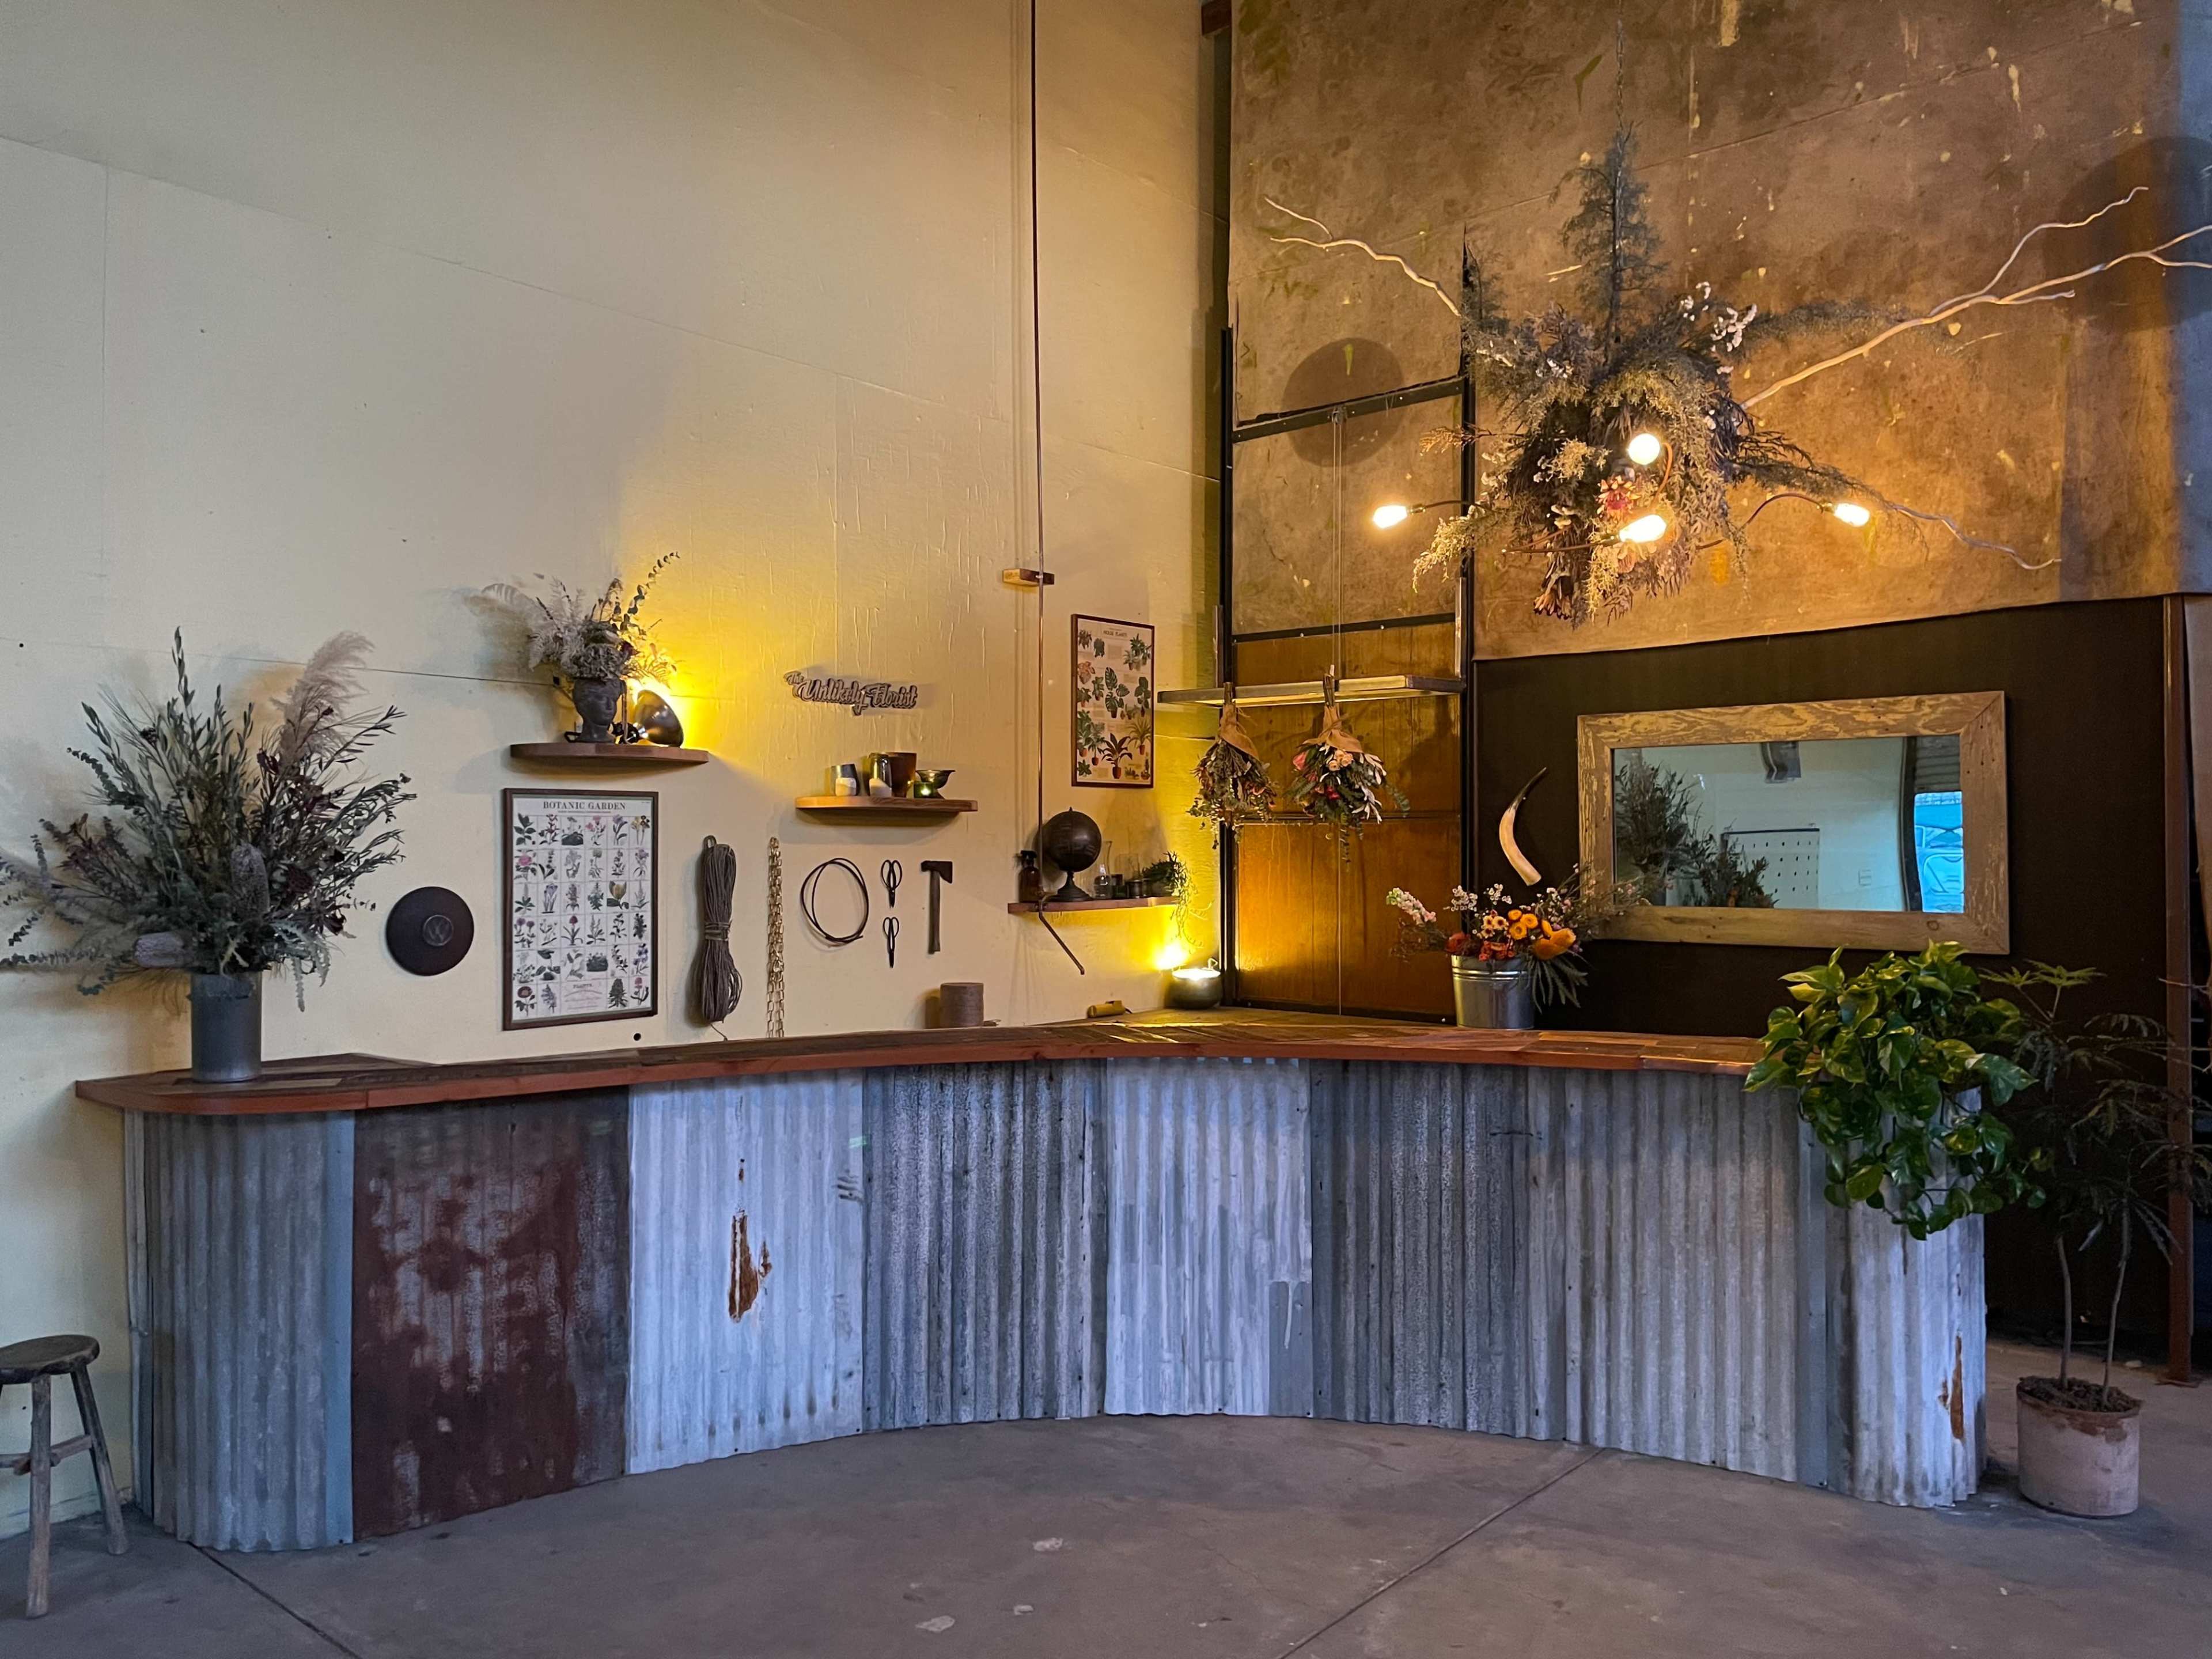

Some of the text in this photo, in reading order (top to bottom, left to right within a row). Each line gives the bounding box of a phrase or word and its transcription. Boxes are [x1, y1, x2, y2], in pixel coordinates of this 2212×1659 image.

[785, 671, 918, 715] The Unlikely Florist
[543, 801, 626, 810] BOTANIC GARDEN
